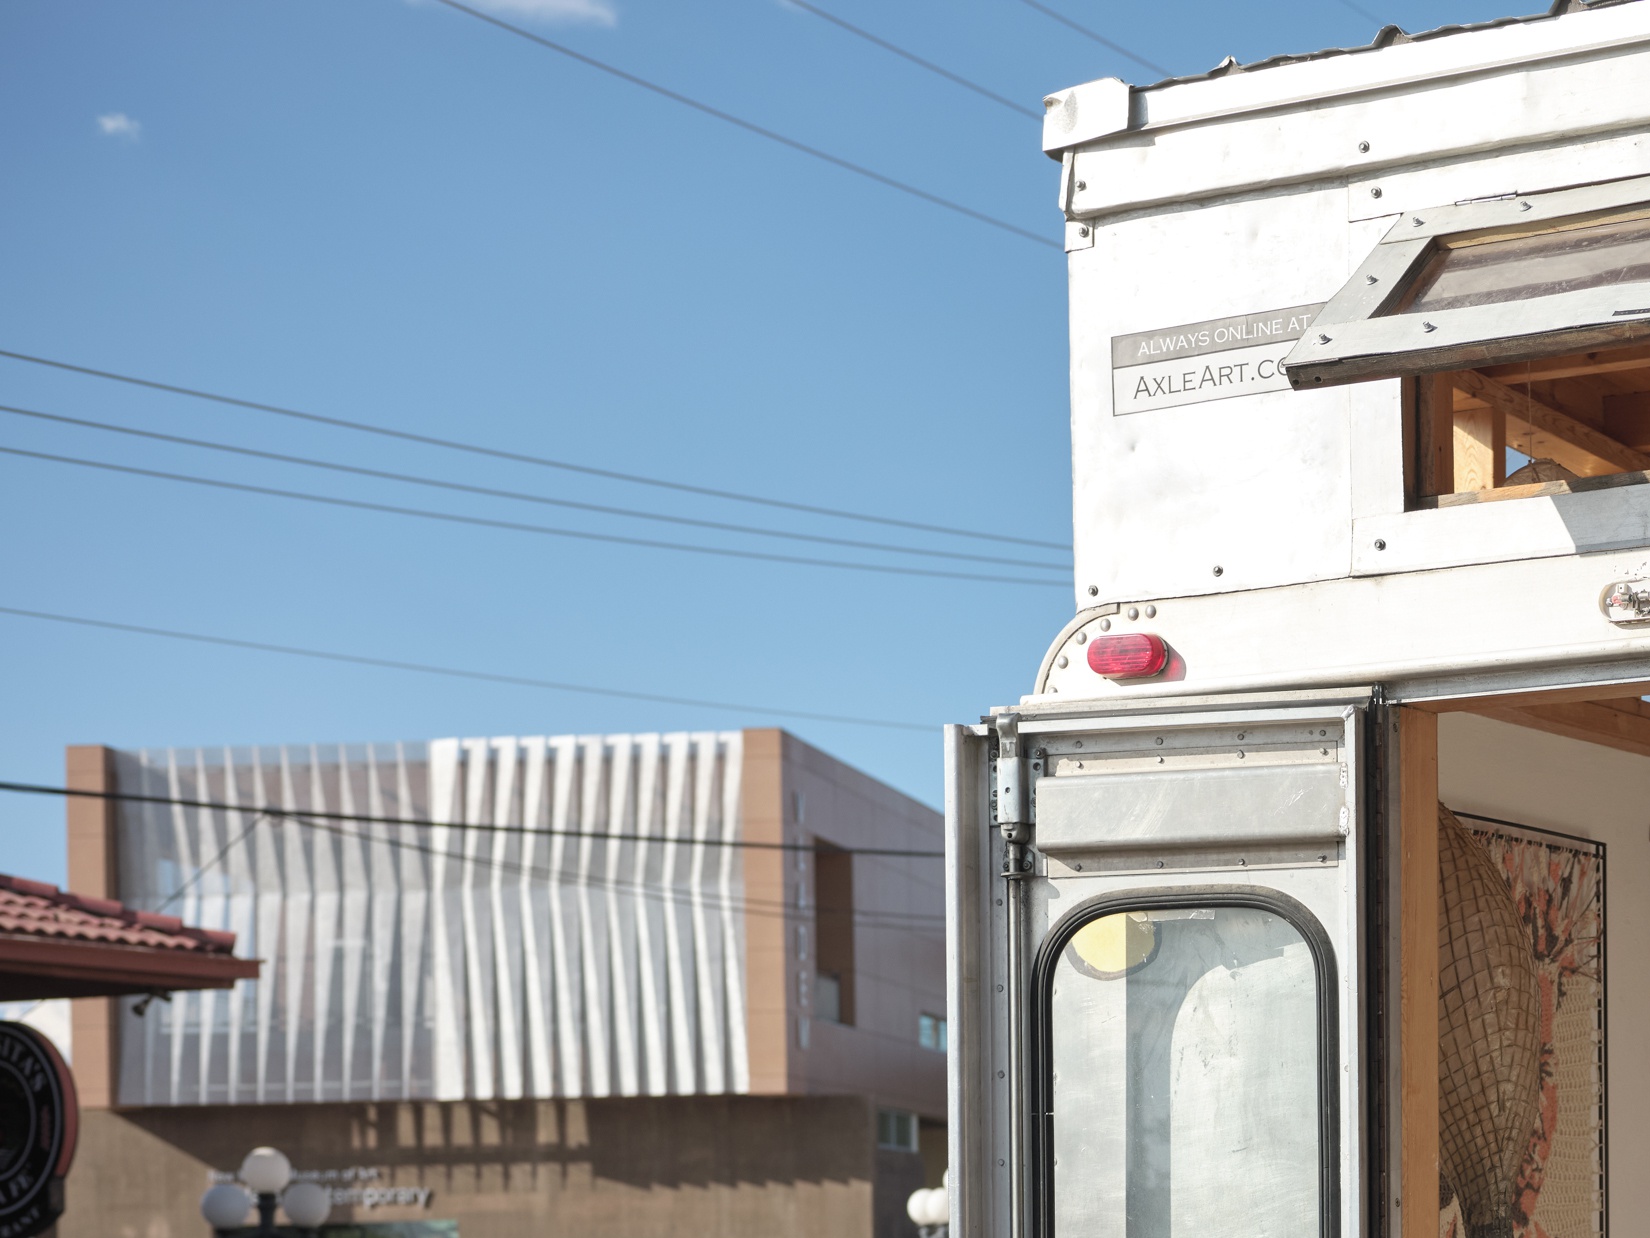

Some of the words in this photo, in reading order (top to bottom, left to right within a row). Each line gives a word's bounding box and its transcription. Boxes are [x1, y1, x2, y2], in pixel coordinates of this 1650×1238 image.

[1138, 331, 1210, 356] ALWAYS
[1214, 318, 1284, 343] ONLINE
[1287, 314, 1311, 331] AT
[1134, 358, 1288, 400] AXLEART.CO
